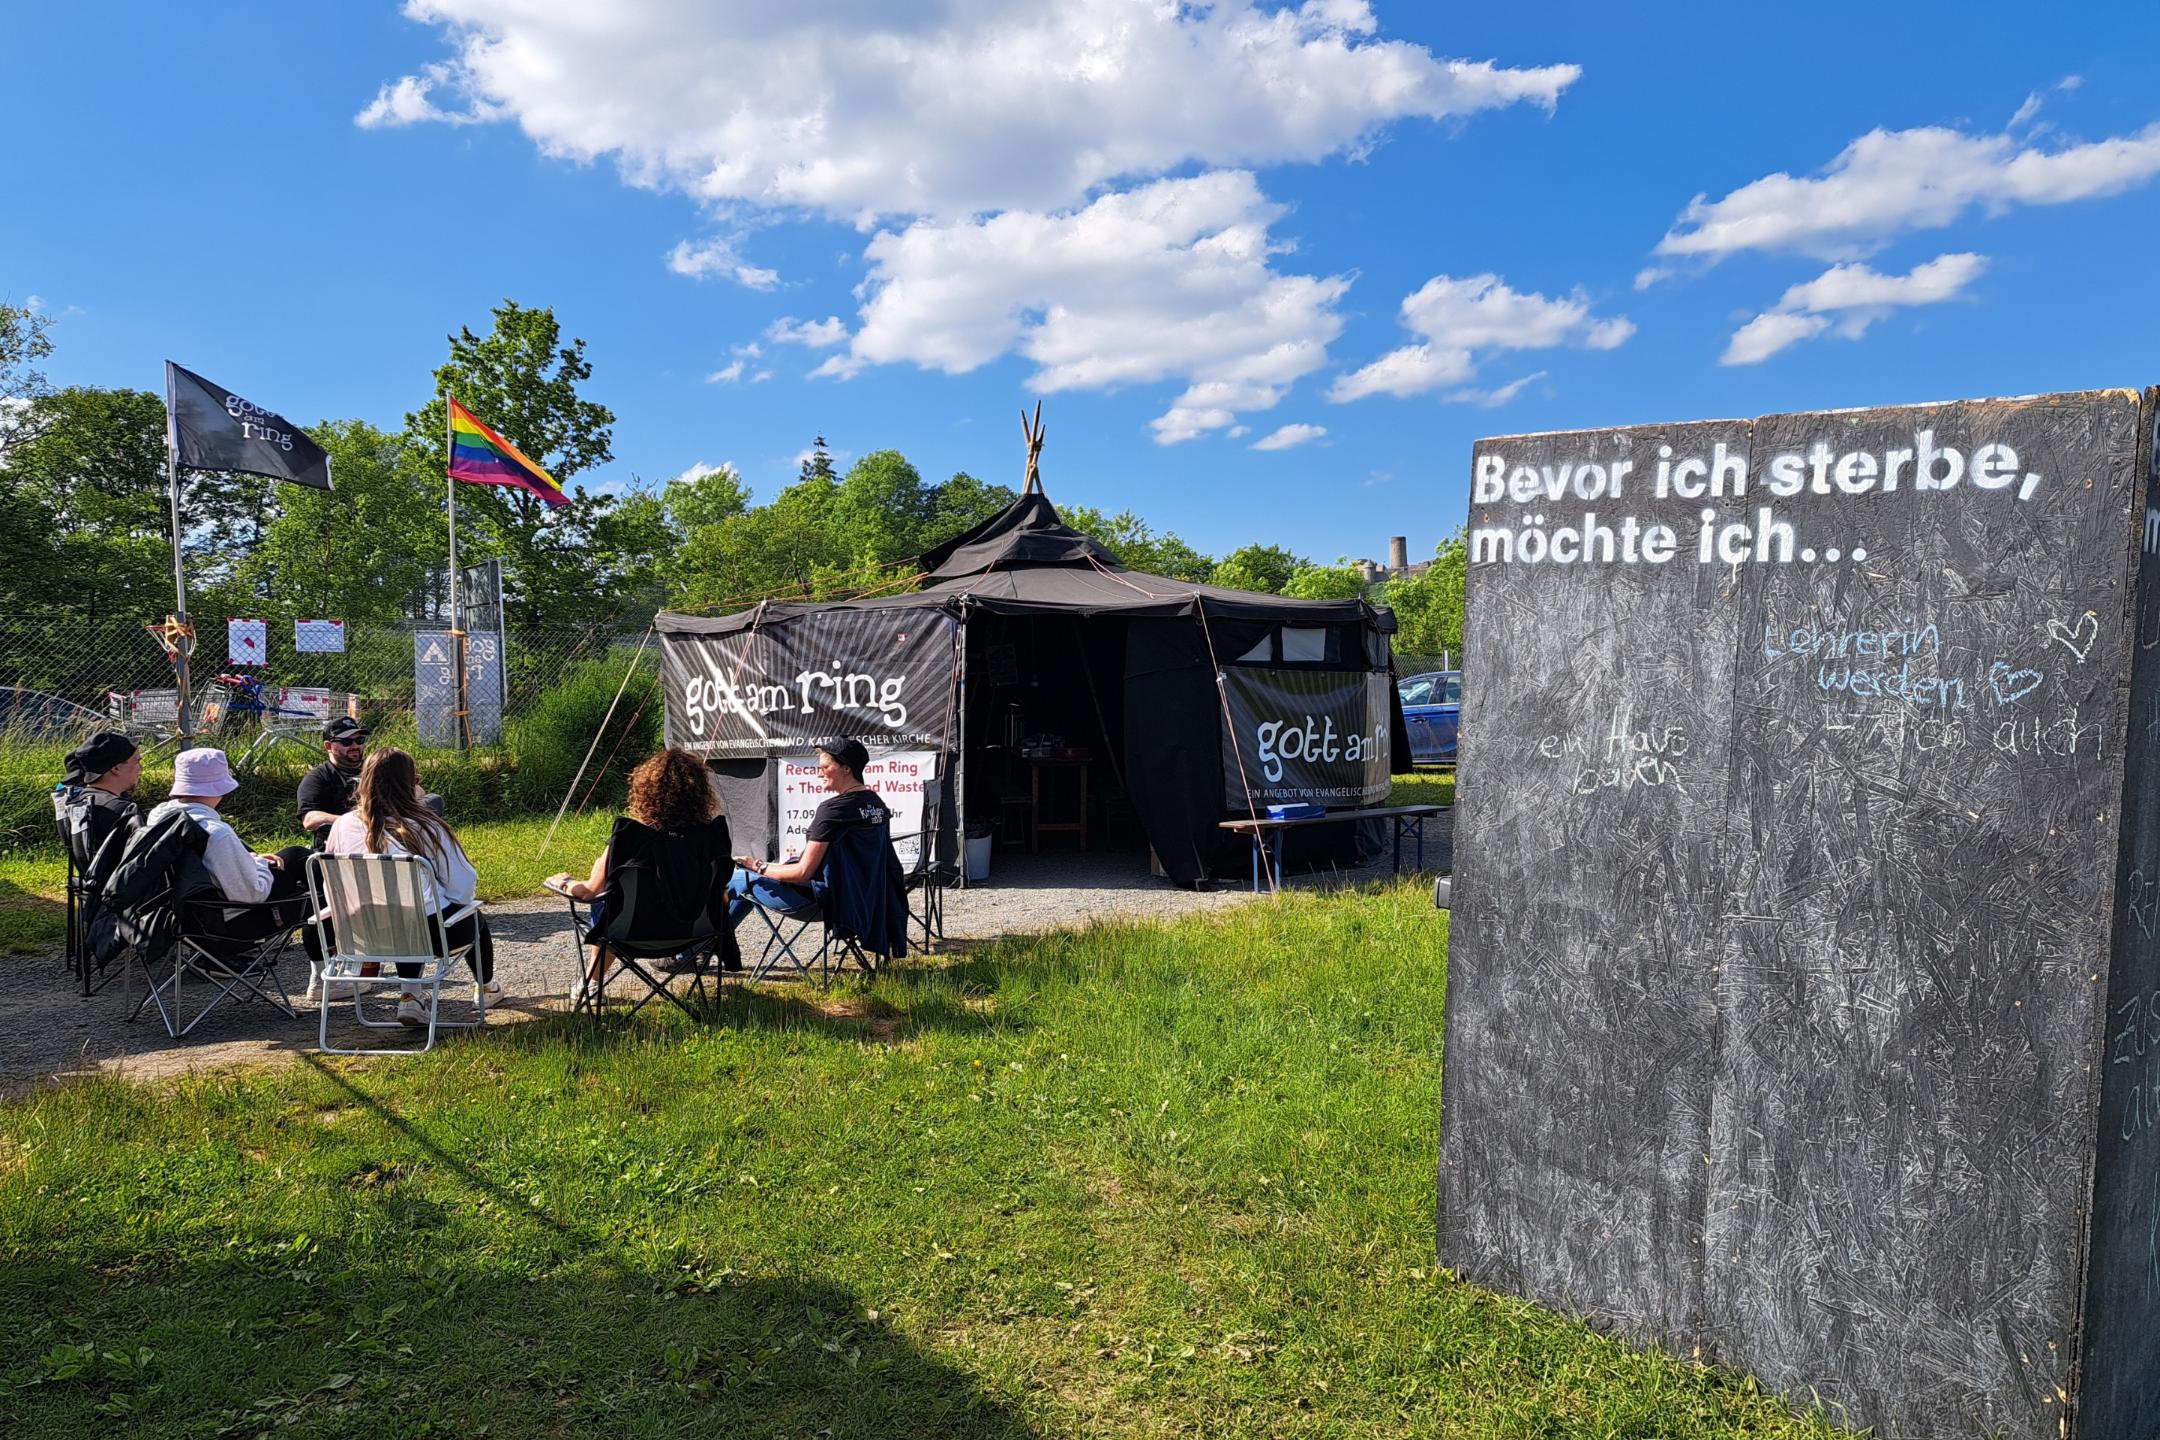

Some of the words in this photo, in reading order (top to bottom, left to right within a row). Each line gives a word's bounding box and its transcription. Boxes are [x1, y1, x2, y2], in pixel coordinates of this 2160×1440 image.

[242, 422, 293, 452] ring
[1474, 455, 1633, 504] Bevor
[1655, 443, 1748, 498] ich
[1768, 429, 2041, 500] sterbe,
[1471, 512, 1677, 563] möchte
[1699, 507, 1867, 564] ich...
[685, 665, 743, 735] gott
[745, 682, 795, 715] am
[795, 659, 907, 727] ring
[1817, 662, 1967, 711] werden
[716, 739, 729, 749] VON
[892, 733, 931, 744] KIRCHE
[1257, 715, 1340, 782] gott
[1344, 734, 1374, 762] am
[864, 764, 884, 774] am
[889, 761, 918, 776] Ring
[885, 780, 924, 793] Waste
[1264, 788, 1298, 798] ANGEBOT
[1300, 788, 1314, 797] VON
